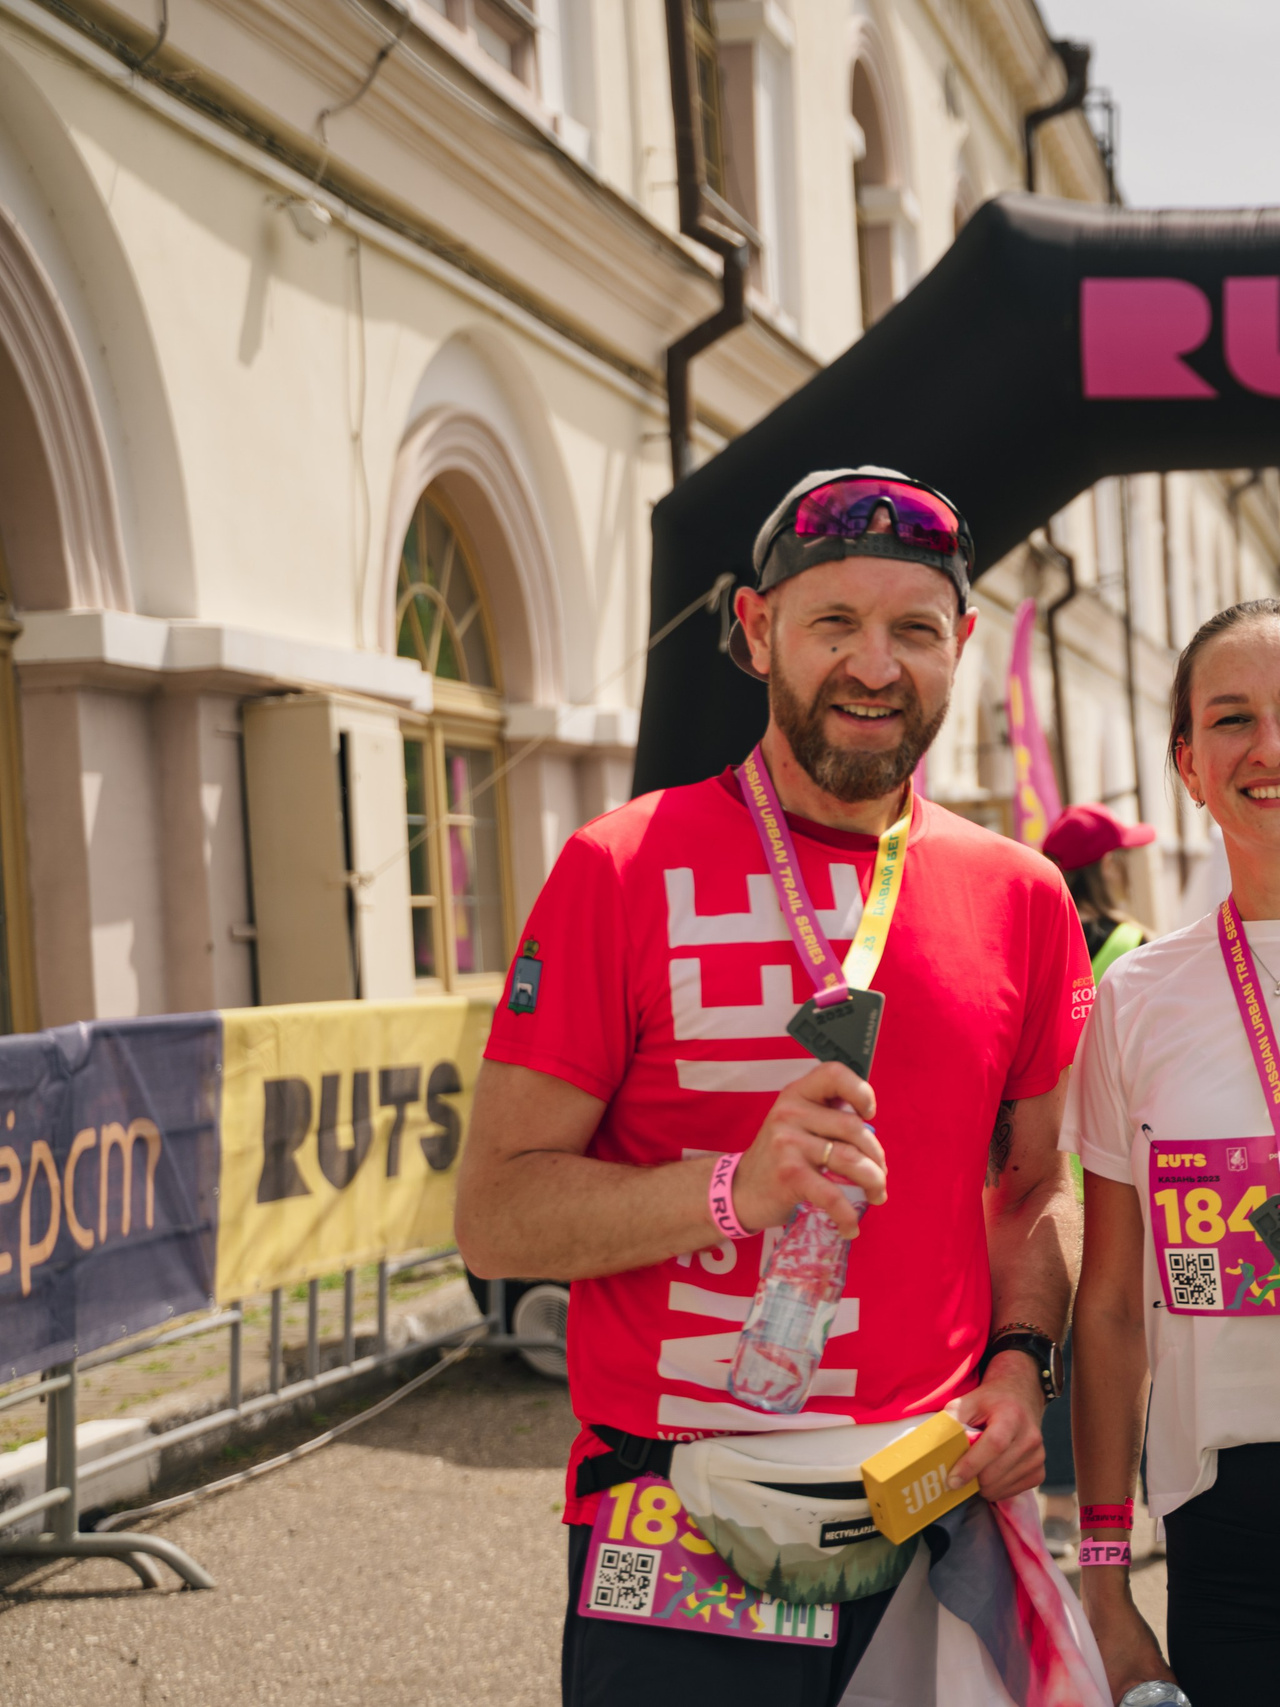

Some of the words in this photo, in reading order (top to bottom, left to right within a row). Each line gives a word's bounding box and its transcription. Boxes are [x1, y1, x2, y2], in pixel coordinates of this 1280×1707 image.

[760, 808, 788, 863] URBAN
[779, 866, 804, 914] TRAIL
[795, 915, 826, 965] SERIES
[872, 864, 895, 917] ДАВАЙ
[1221, 899, 1238, 941] SERIE
[1230, 940, 1250, 984] TRAIL
[815, 1004, 855, 1025] 2023
[1241, 982, 1266, 1037] URBAN
[257, 1061, 463, 1204] RUTS
[1157, 1153, 1207, 1168] RUTS
[1197, 1175, 1220, 1183] 2023
[1154, 1185, 1268, 1244] 184
[1079, 1547, 1131, 1562] ВТРА
